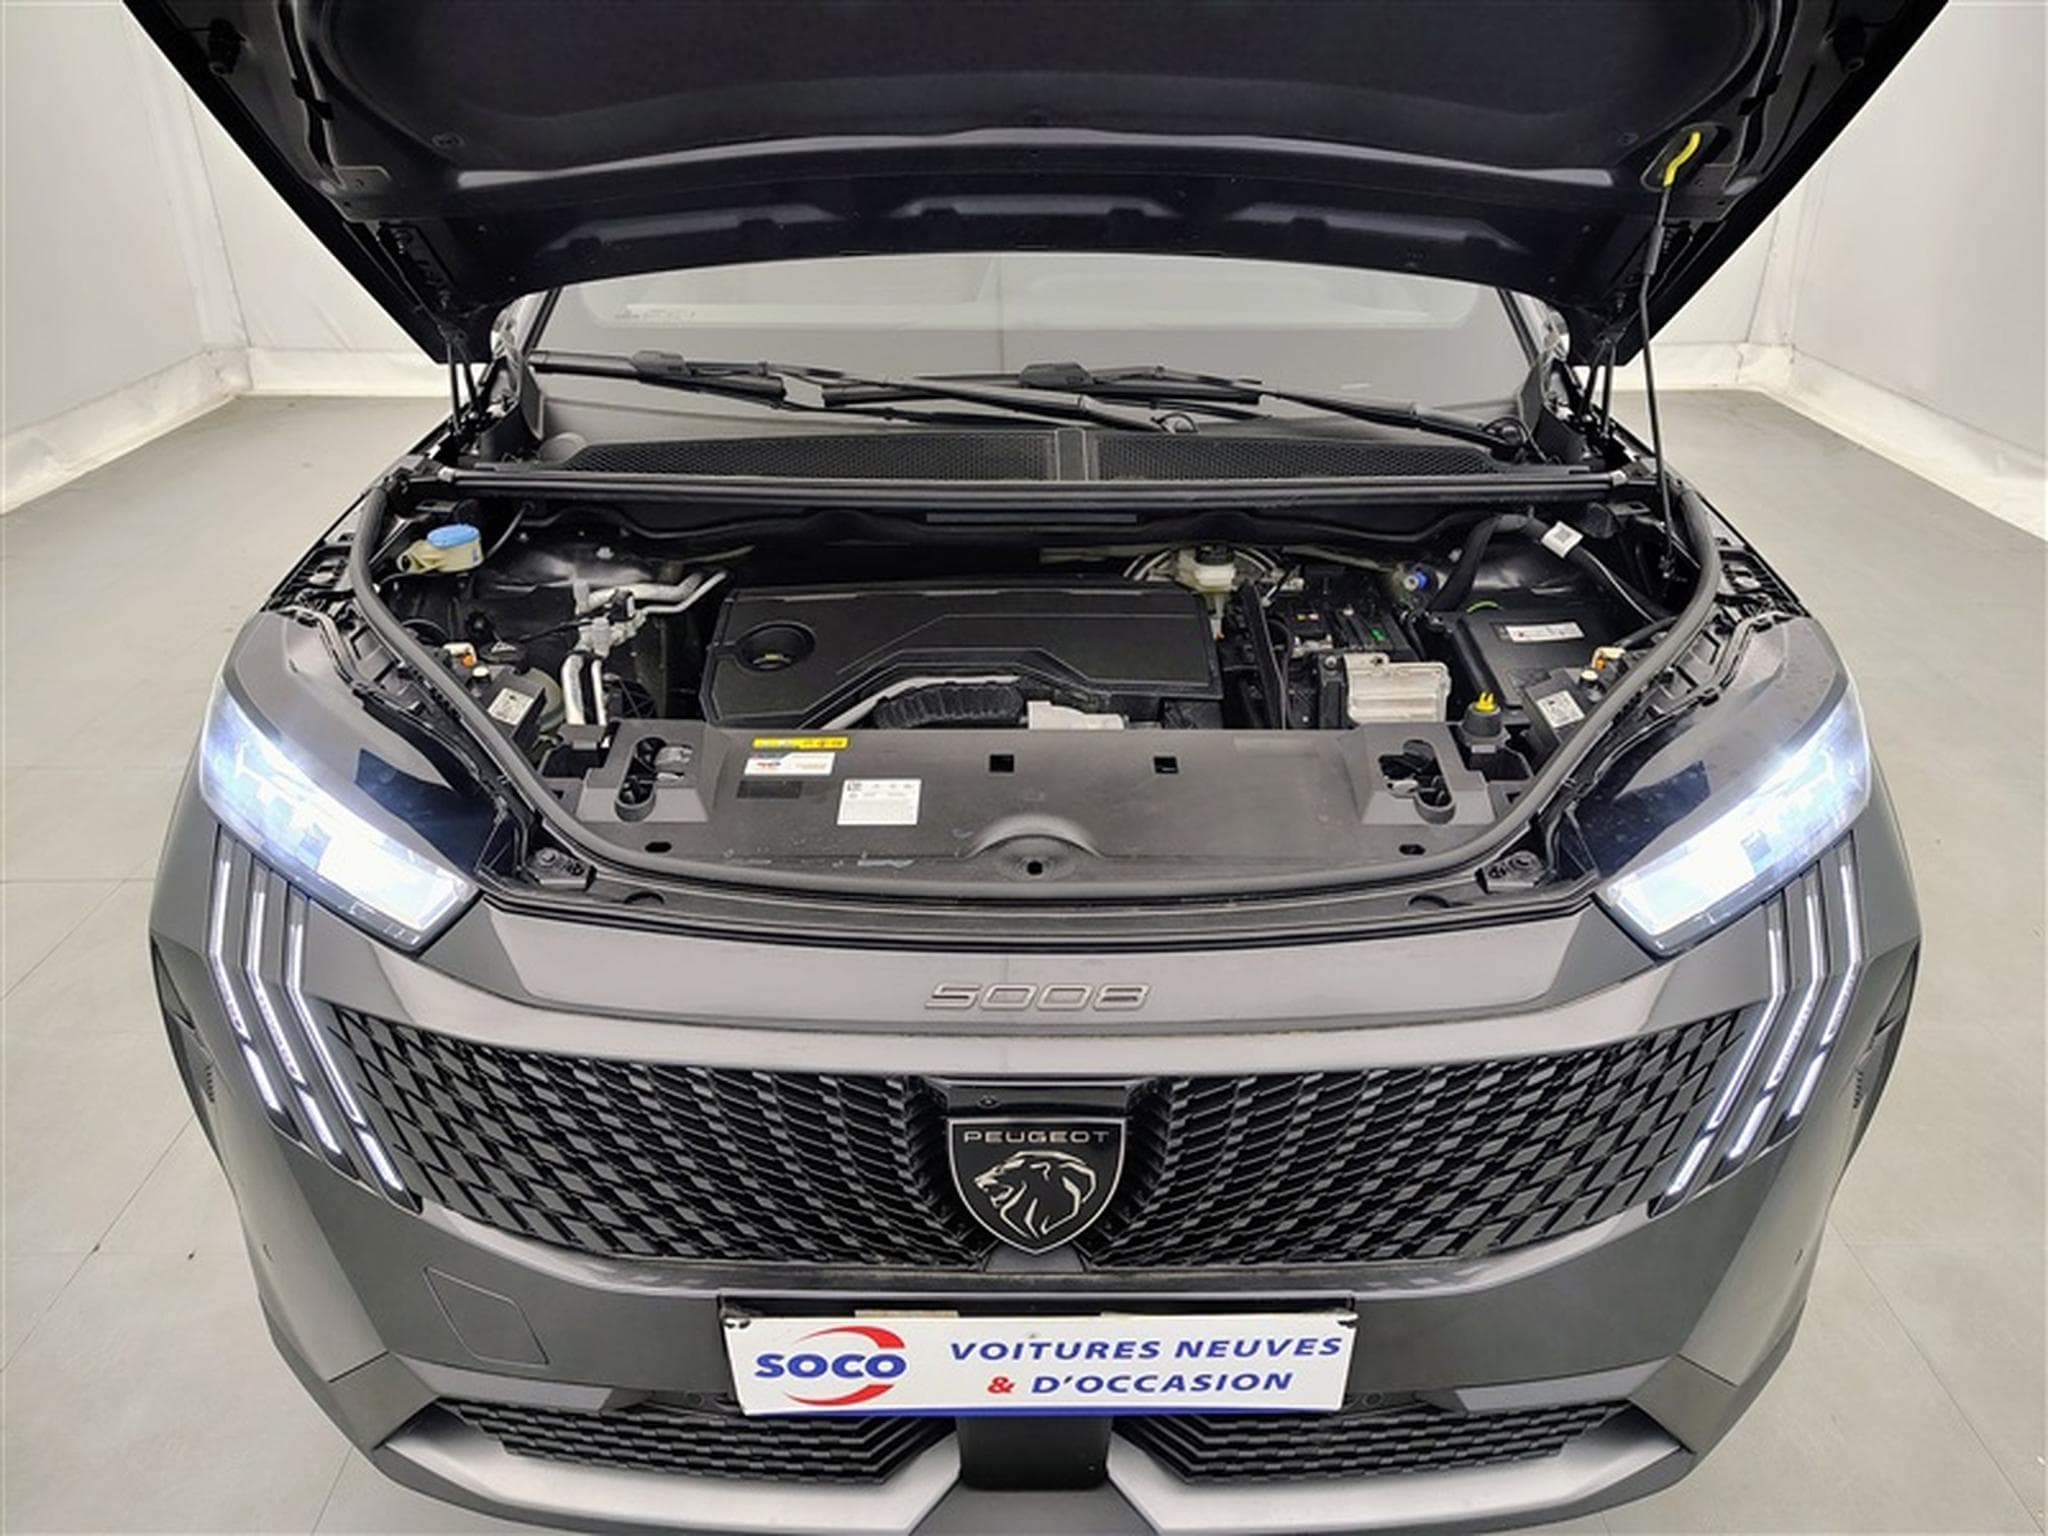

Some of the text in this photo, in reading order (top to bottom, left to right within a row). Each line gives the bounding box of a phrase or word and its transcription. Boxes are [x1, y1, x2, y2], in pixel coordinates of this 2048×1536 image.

[924, 983, 1151, 1012] 5008
[963, 1130, 1110, 1144] PEUGEOT
[950, 1337, 1342, 1361] VOITURES NEUVES
[755, 1353, 907, 1379] SOCO
[986, 1372, 1293, 1395] & D'OCCASION
